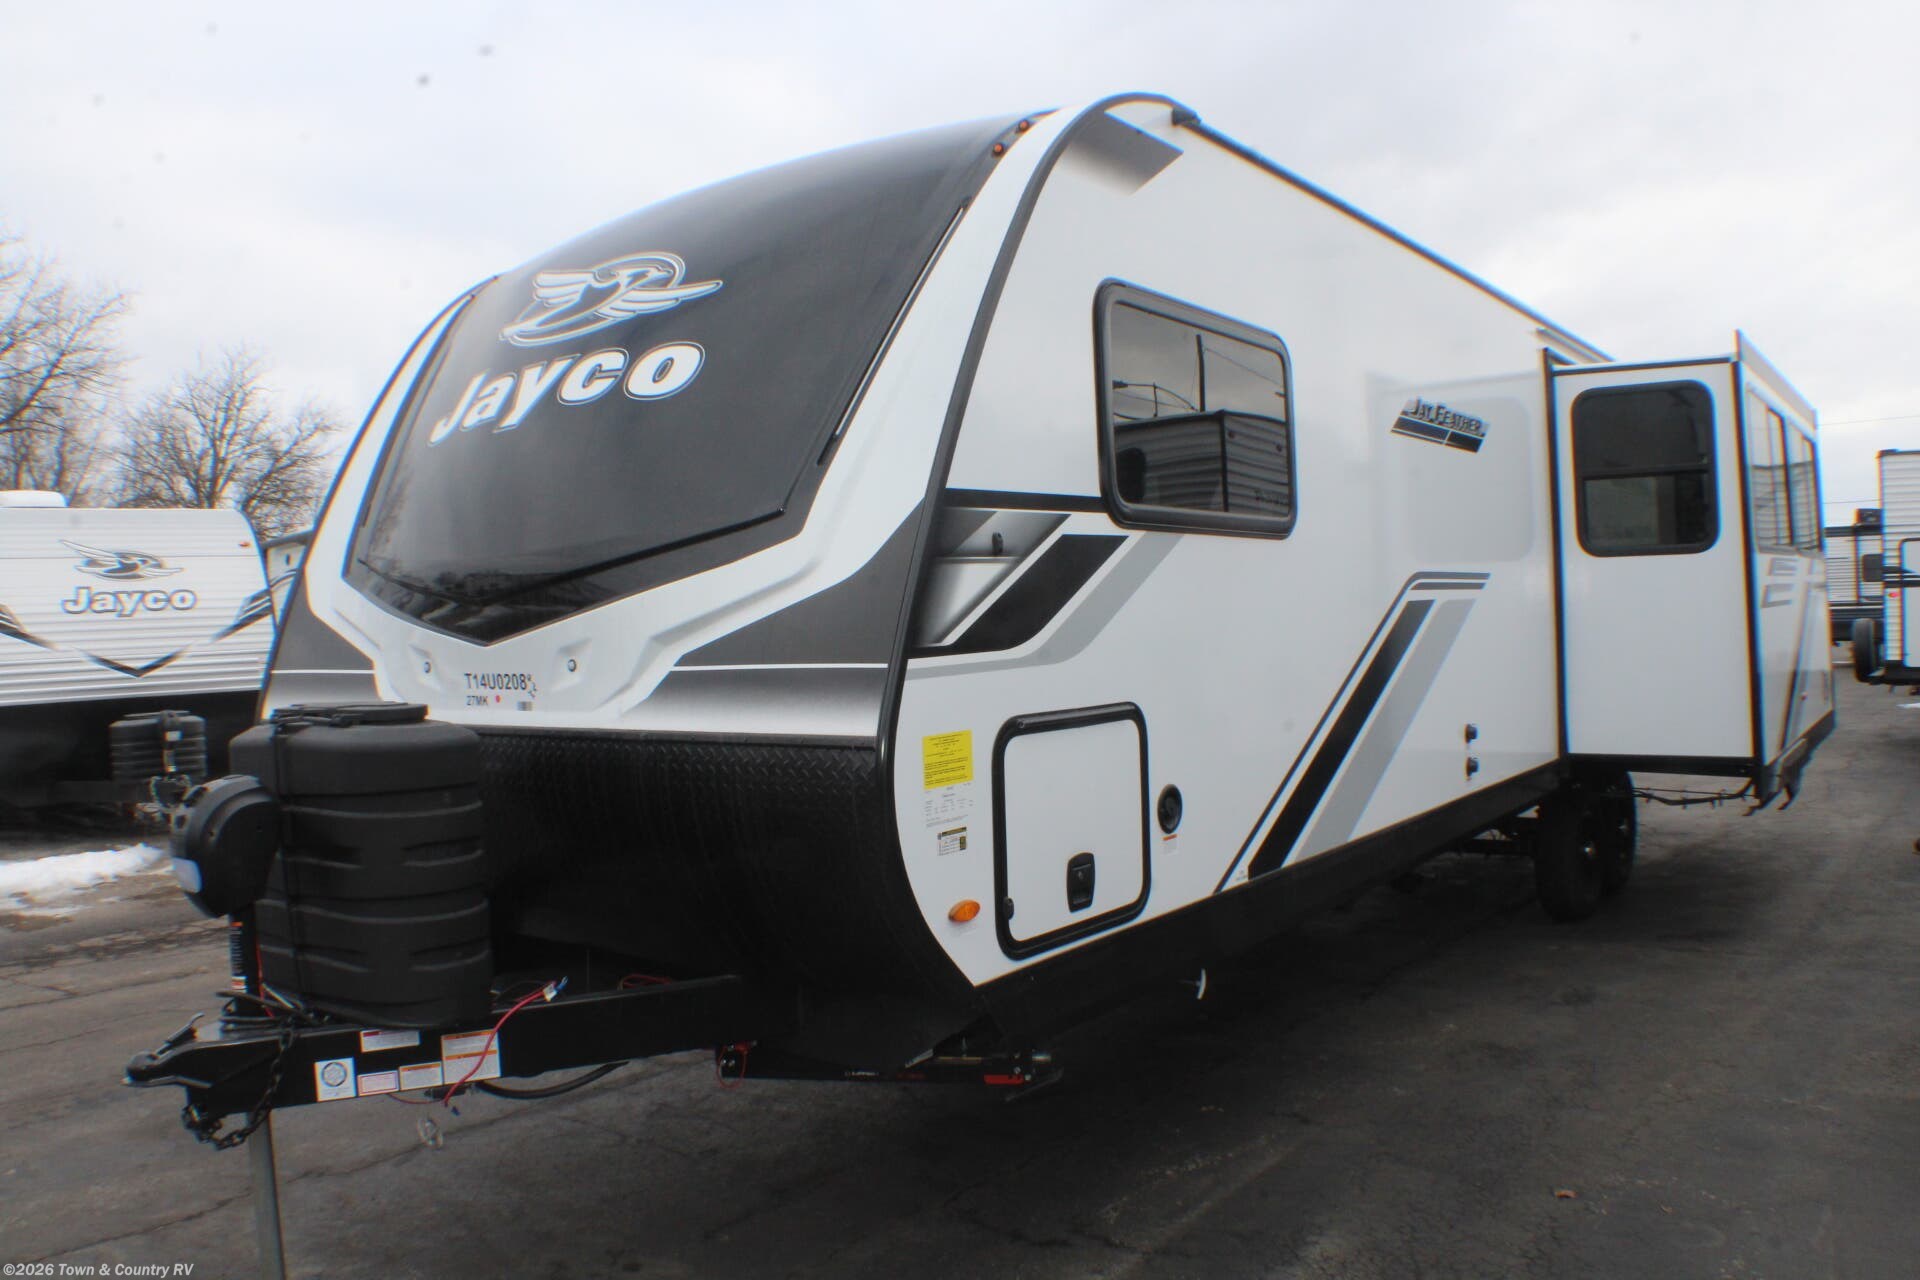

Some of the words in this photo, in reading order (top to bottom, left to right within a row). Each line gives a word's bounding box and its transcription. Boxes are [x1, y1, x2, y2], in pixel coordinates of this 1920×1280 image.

[427, 341, 705, 447] Jayco
[61, 586, 198, 618] Jayco
[464, 672, 527, 690] T14U0208
